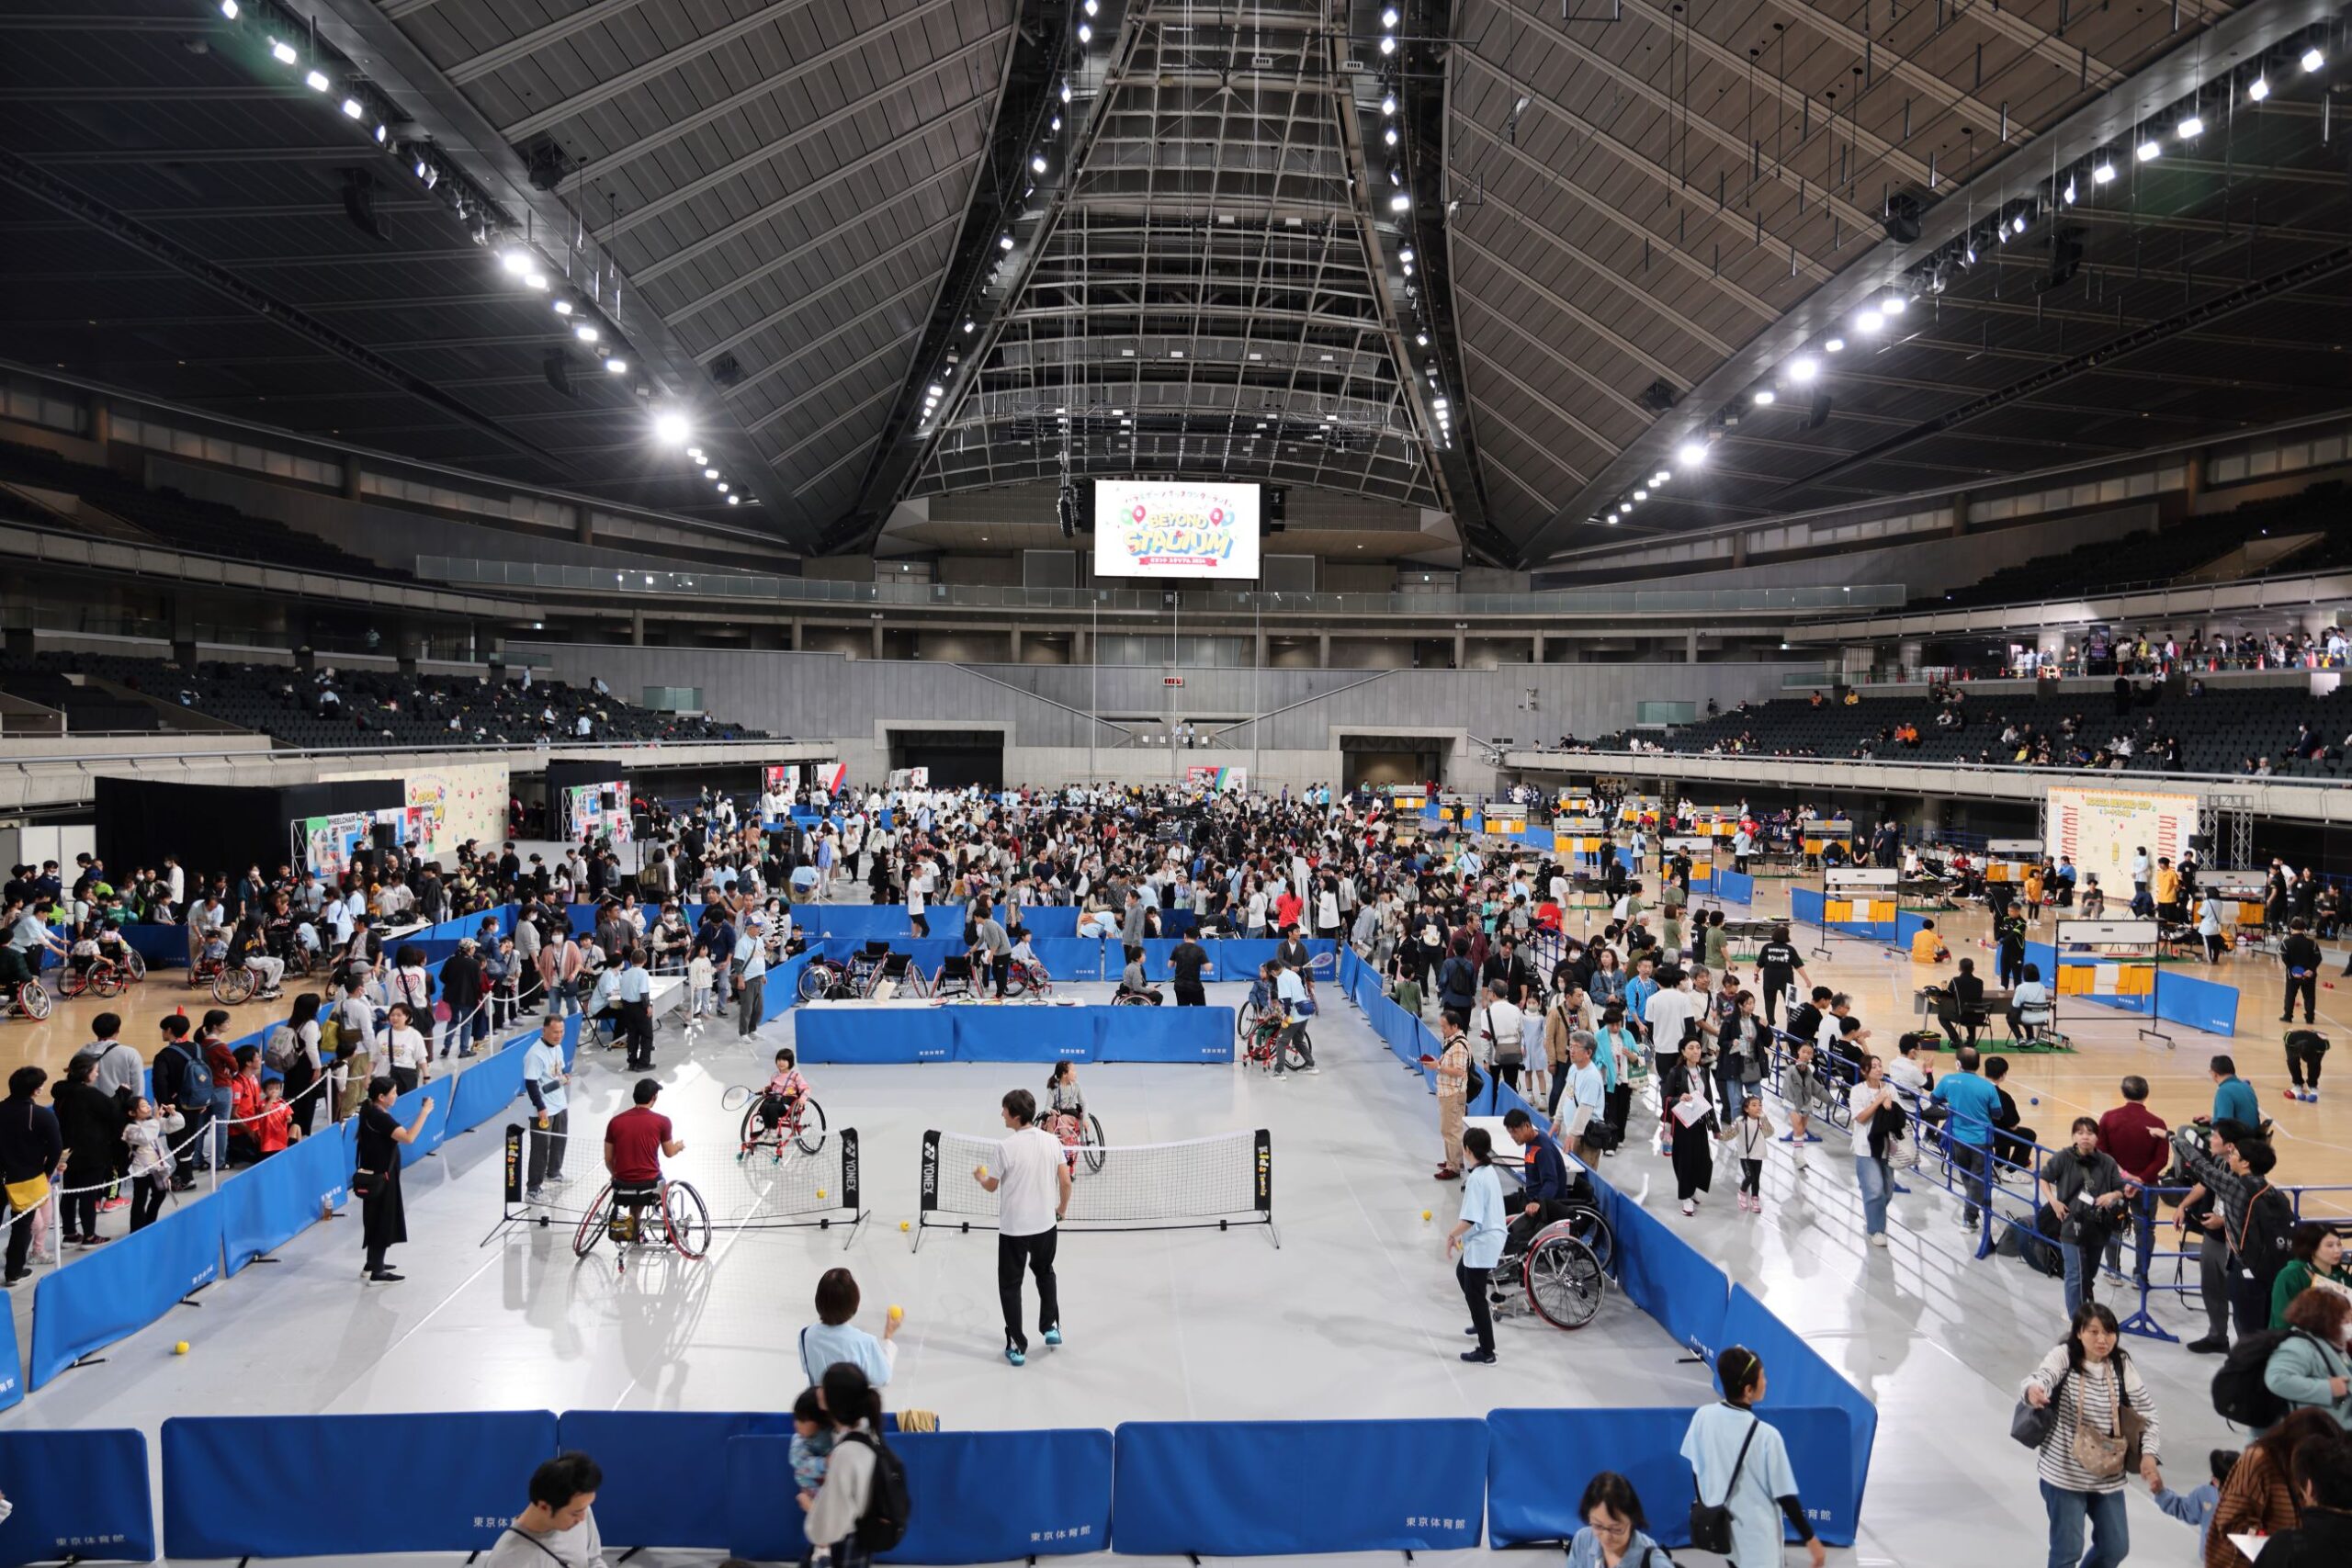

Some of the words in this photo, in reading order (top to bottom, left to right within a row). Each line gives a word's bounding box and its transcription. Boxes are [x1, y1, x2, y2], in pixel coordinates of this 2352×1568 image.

[1149, 513, 1208, 529] BEYOND
[1124, 529, 1233, 558] STADIUM
[508, 1135, 519, 1164] Kids
[1258, 1146, 1269, 1173] Kids
[845, 1159, 856, 1191] YONEX
[923, 1162, 934, 1196] YONEX
[1031, 1525, 1091, 1542] 東京体育館
[1405, 1517, 1465, 1529] 東京体育館
[55, 1534, 125, 1546] 東京体育館
